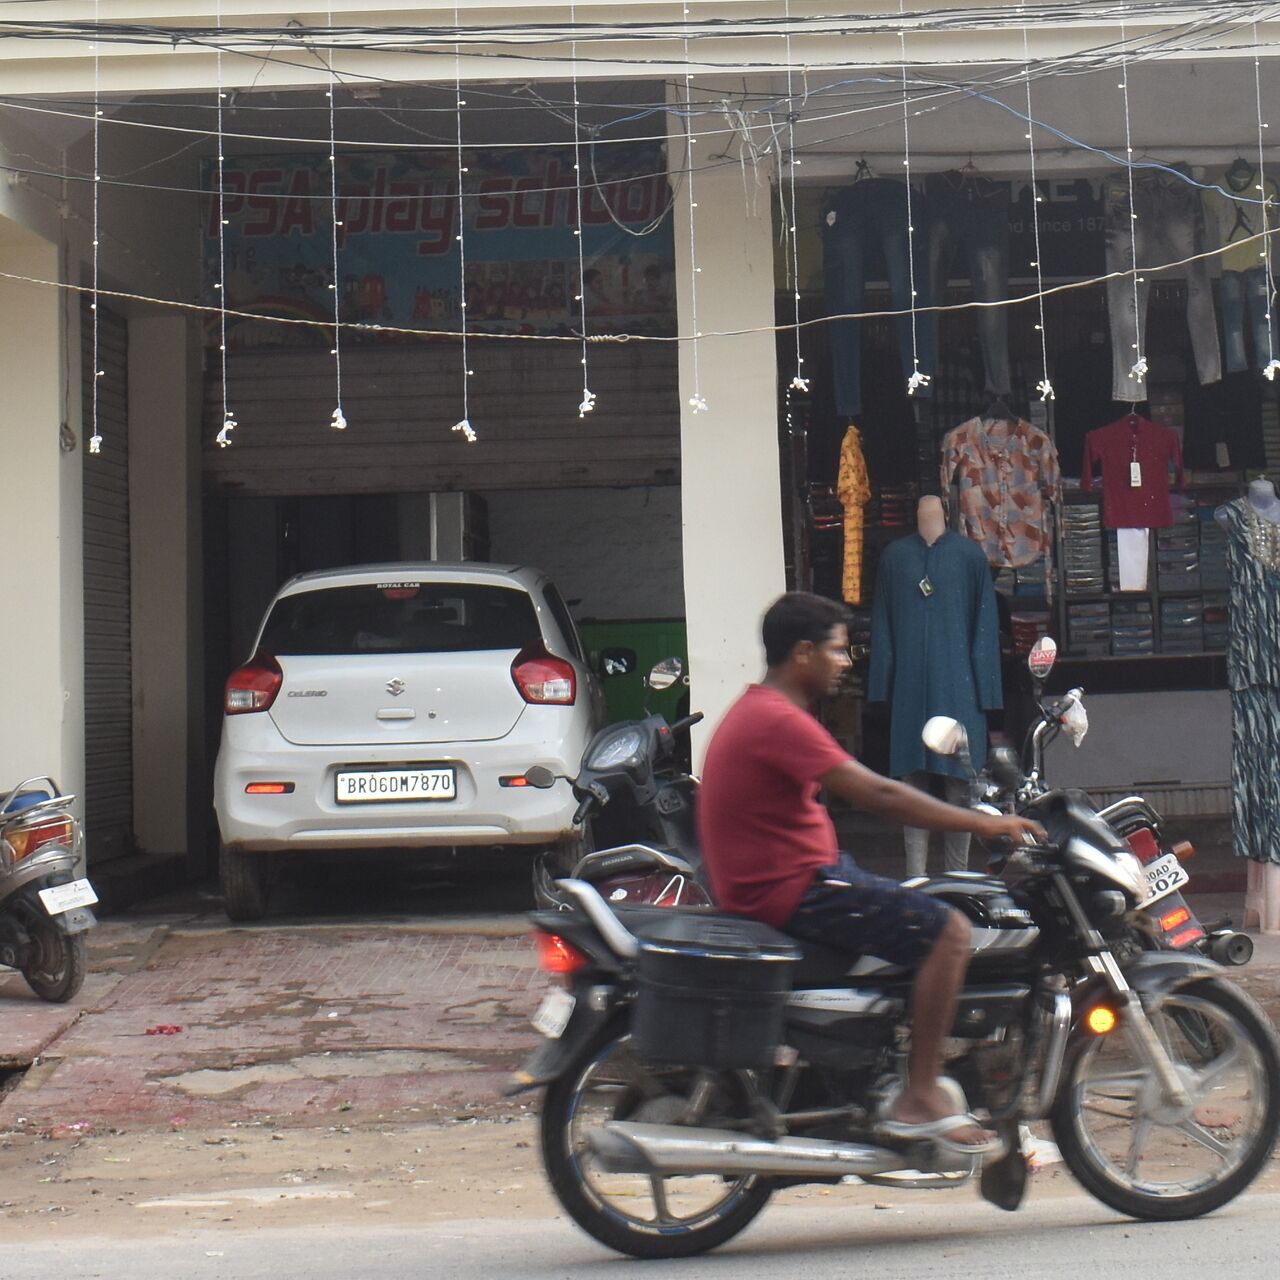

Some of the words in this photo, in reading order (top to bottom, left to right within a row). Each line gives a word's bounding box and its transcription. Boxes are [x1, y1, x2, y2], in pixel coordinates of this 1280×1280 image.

[208, 169, 318, 239] PSA
[333, 166, 457, 256] play
[474, 161, 675, 228] school
[1028, 218, 1072, 233] since
[1077, 216, 1106, 232] 187
[287, 690, 328, 698] CELERIO
[347, 773, 451, 794] BR06DM7870
